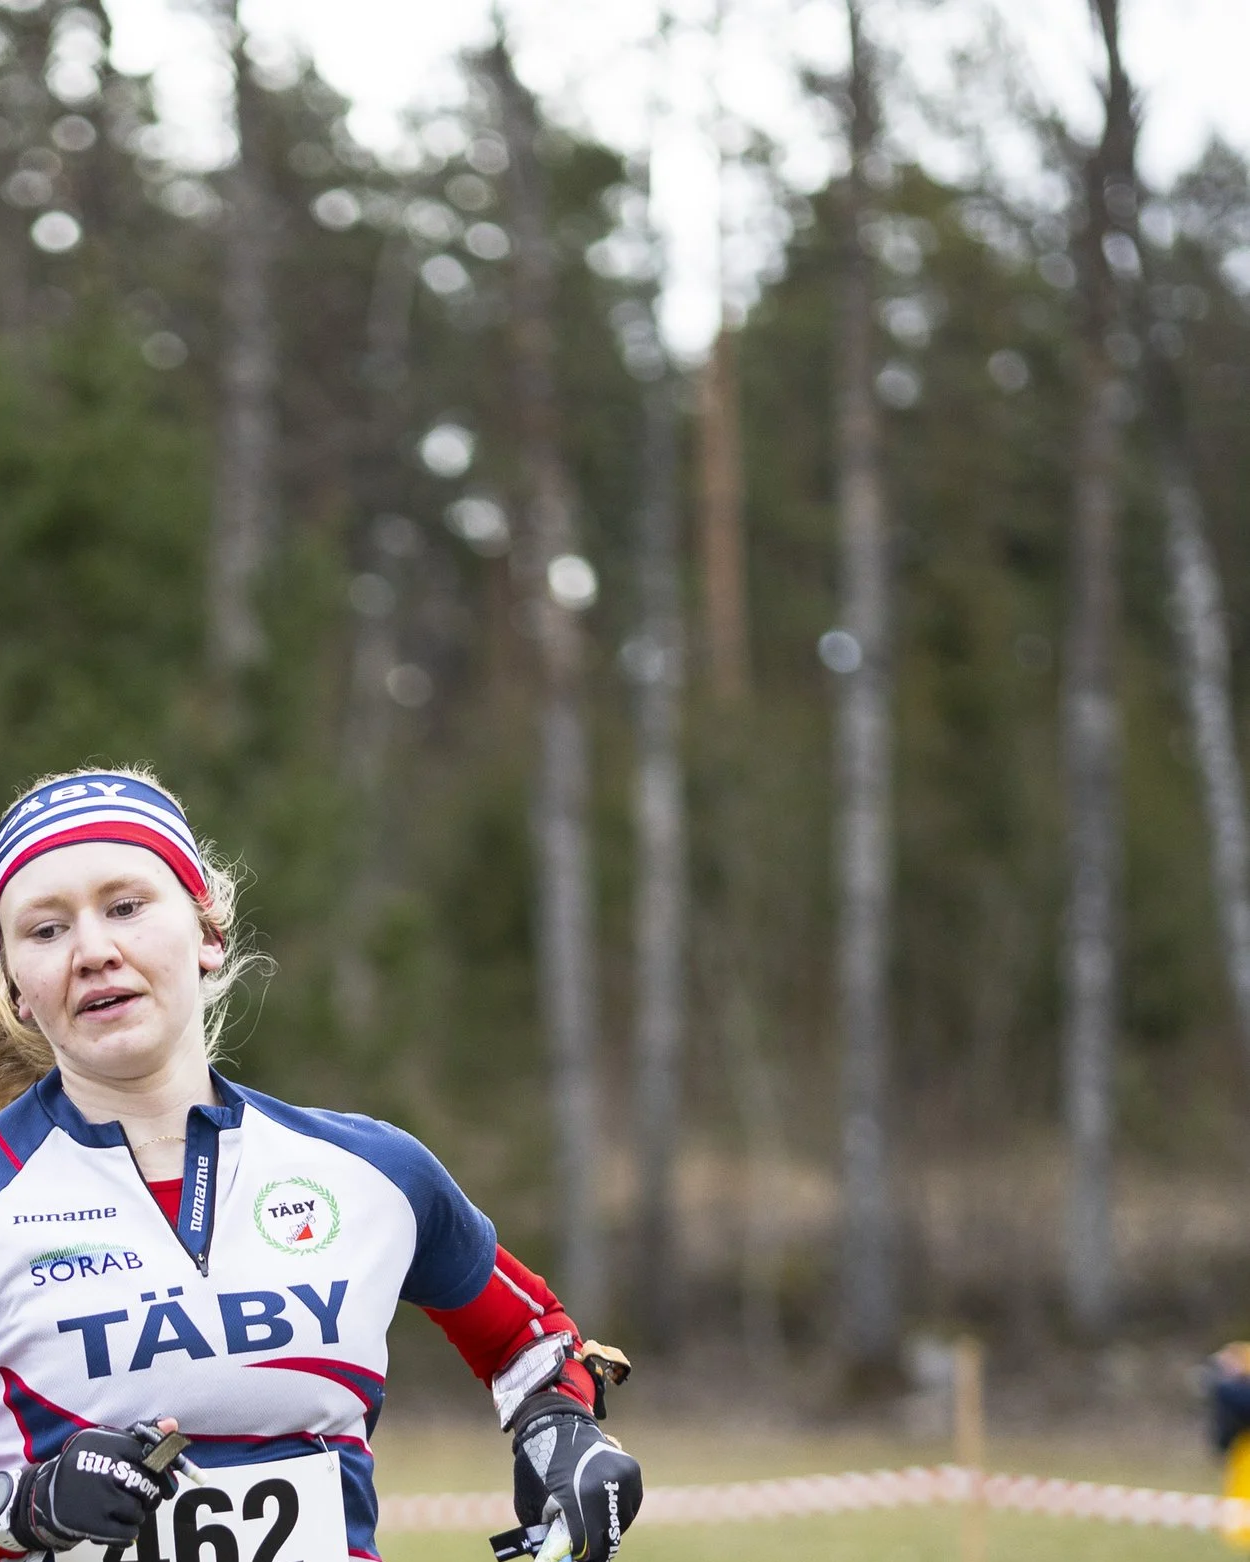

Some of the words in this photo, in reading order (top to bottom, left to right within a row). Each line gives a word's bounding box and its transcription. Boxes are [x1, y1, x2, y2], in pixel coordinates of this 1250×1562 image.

[12, 1207, 117, 1225] noname
[189, 1155, 209, 1232] noname
[268, 1200, 315, 1219] TÄBY
[57, 1280, 349, 1380] TÄBY
